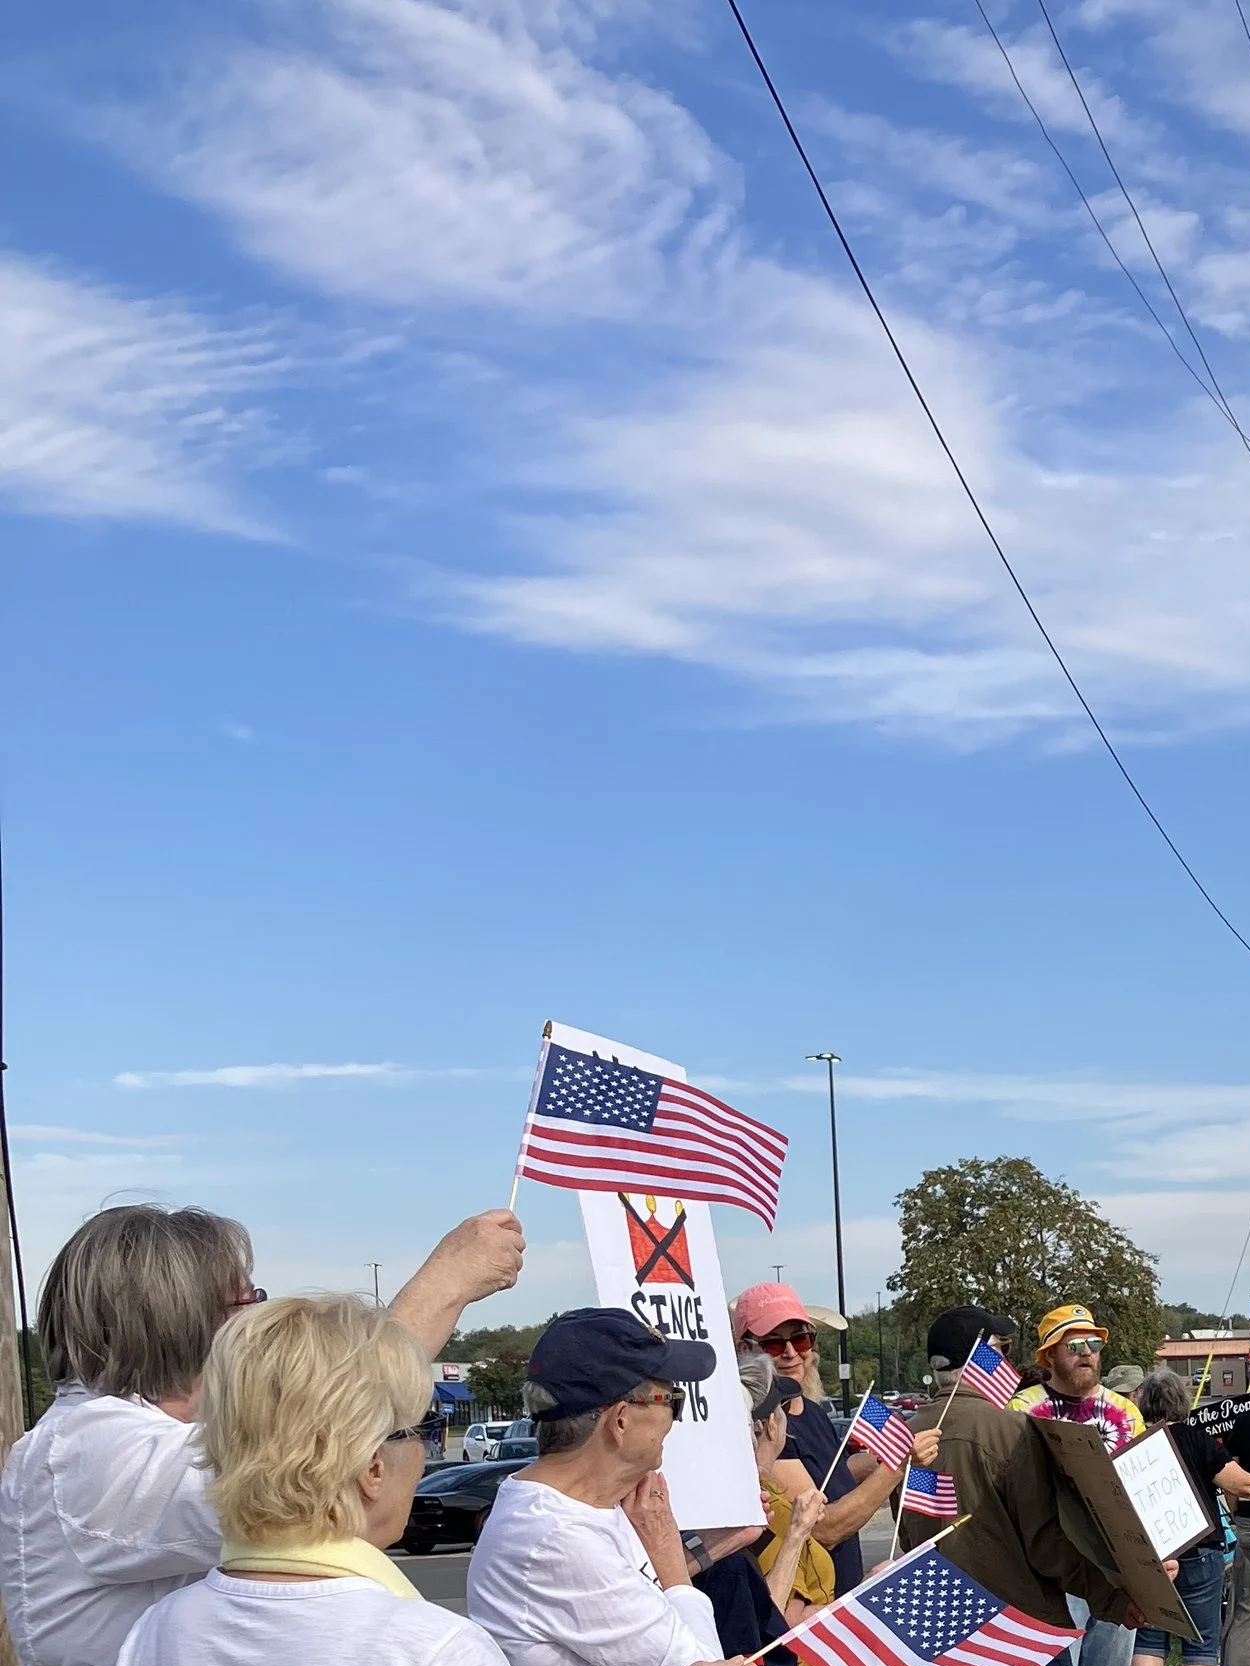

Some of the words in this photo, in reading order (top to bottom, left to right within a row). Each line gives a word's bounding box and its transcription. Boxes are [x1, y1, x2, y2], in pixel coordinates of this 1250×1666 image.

[631, 1290, 708, 1340] SINCE
[1198, 1408, 1219, 1424] the
[1205, 1419, 1236, 1435] SAYIN
